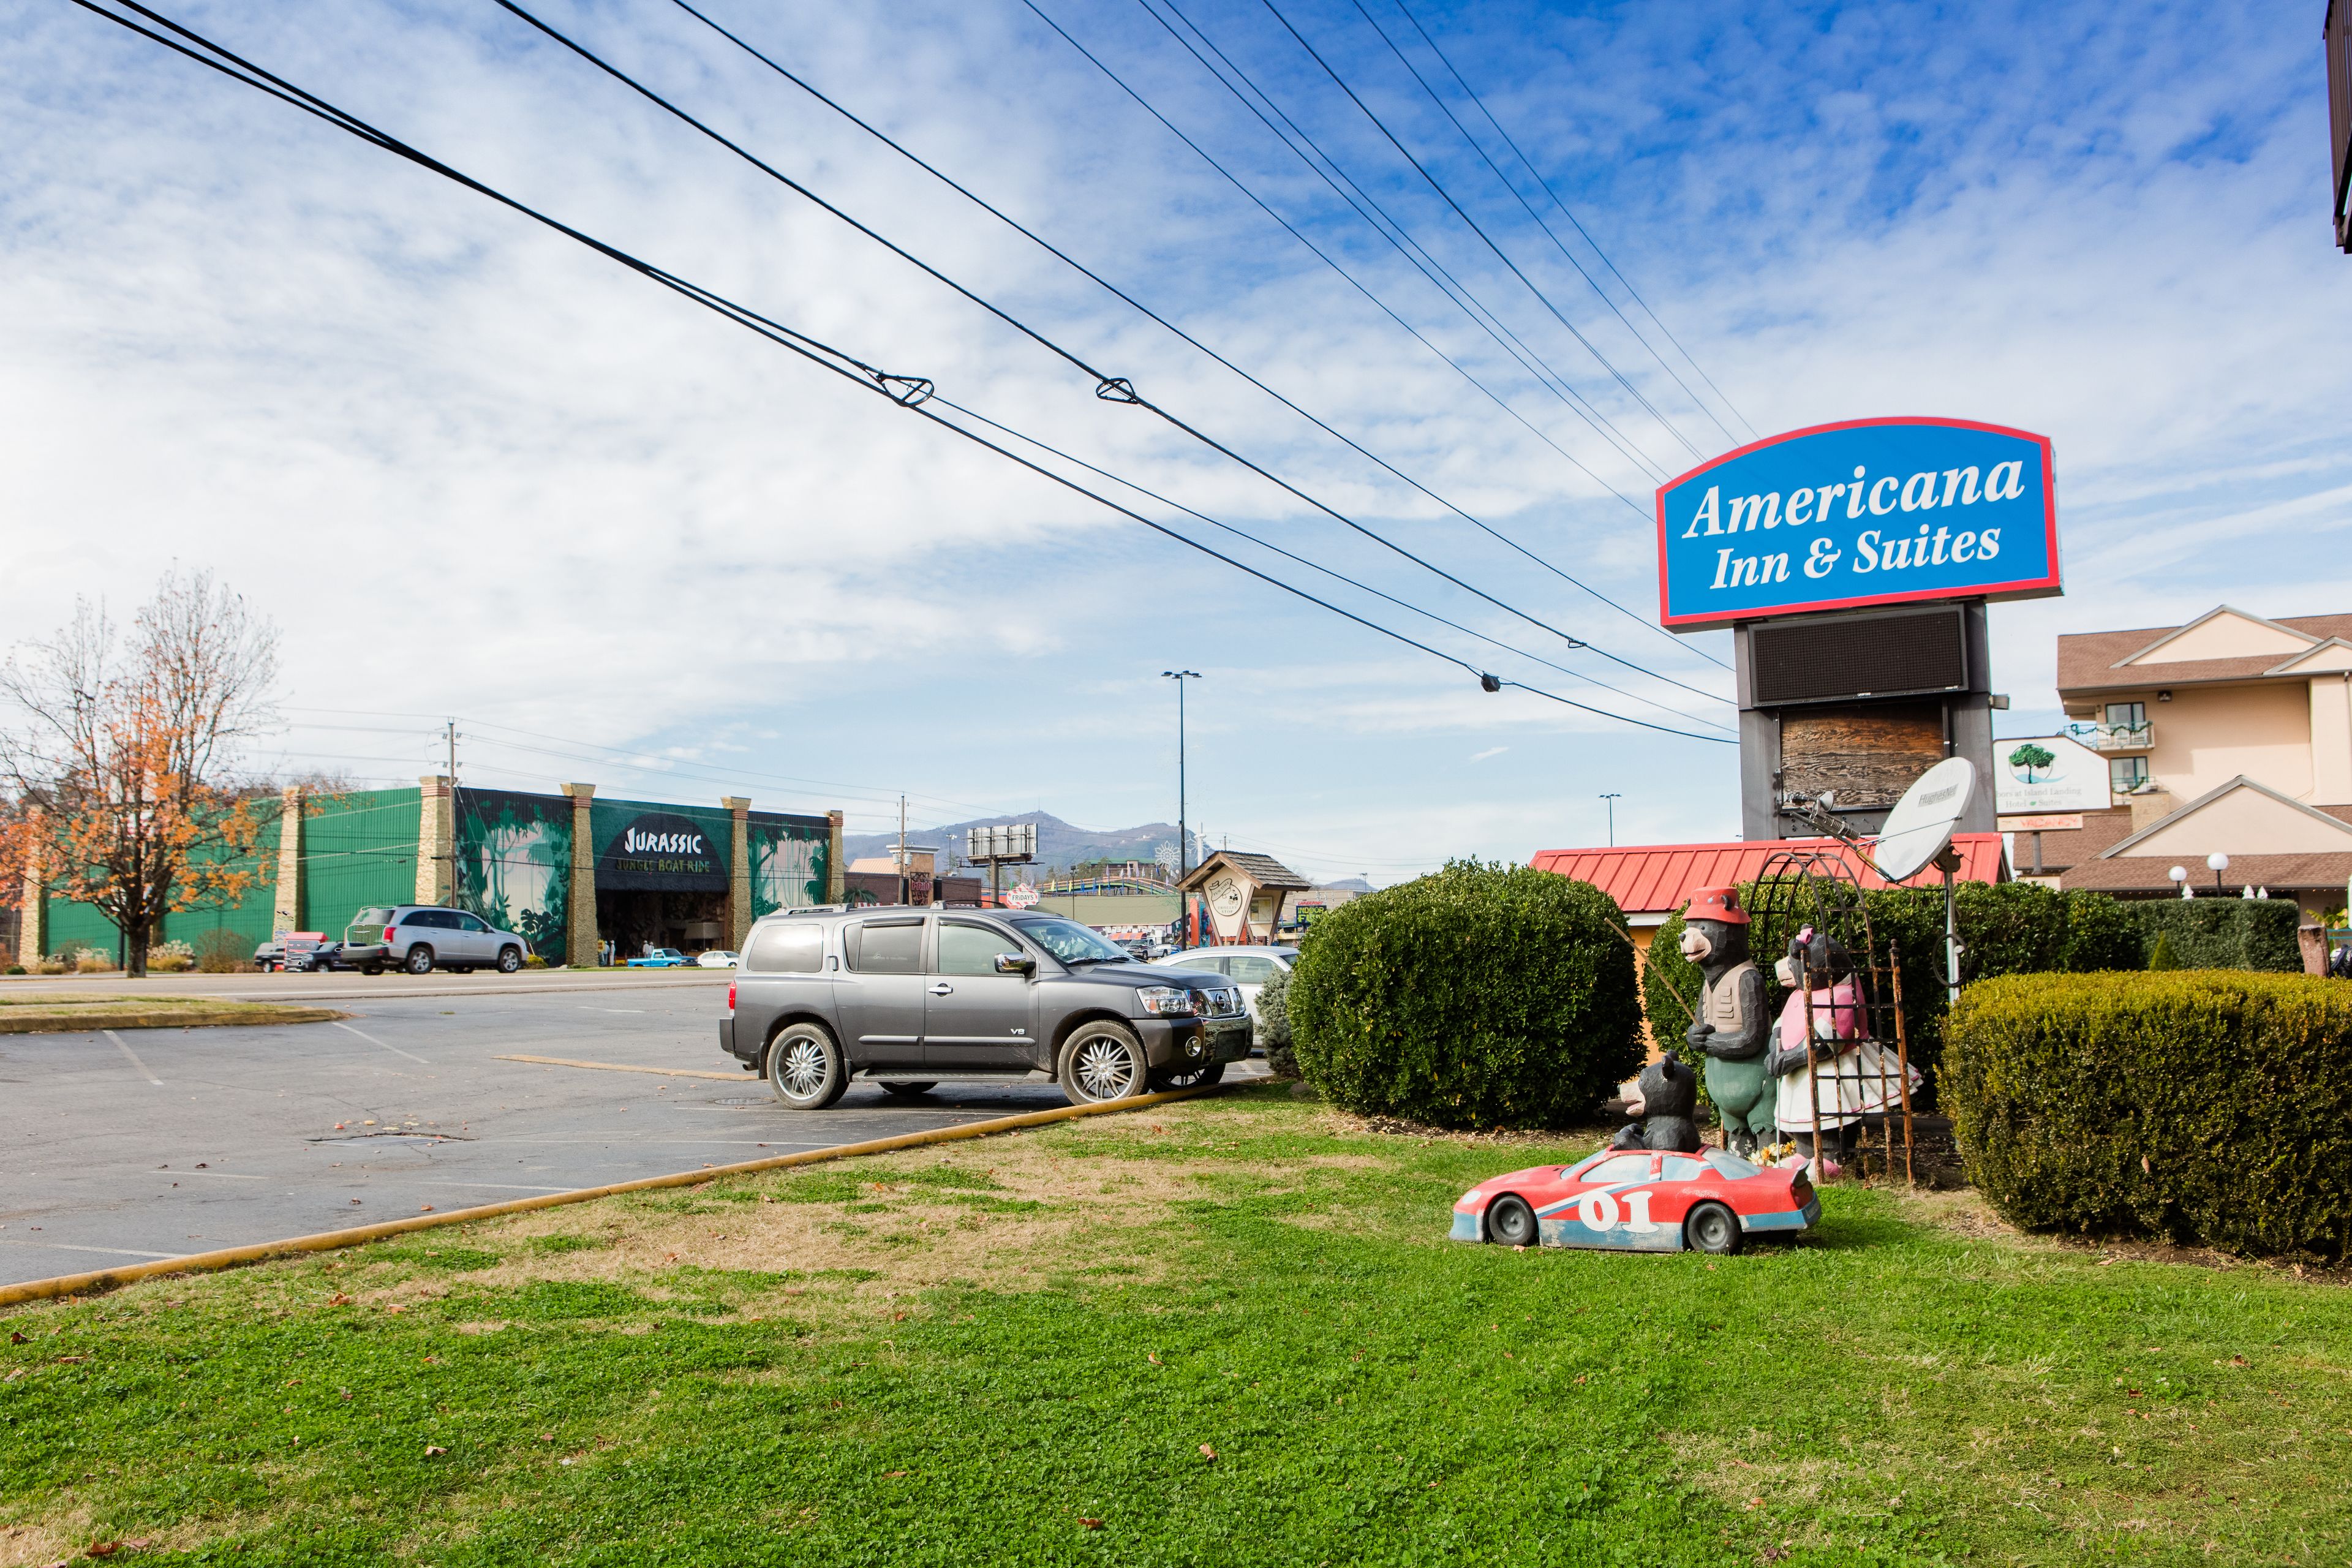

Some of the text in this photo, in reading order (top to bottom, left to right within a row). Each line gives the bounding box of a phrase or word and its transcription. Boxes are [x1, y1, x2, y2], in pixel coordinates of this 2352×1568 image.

[1682, 461, 2025, 539] Americana
[1709, 524, 2001, 589] Inn & Suites
[1918, 785, 1958, 805] HughesNet
[2024, 788, 2048, 796] Island
[2050, 786, 2081, 796] Landing
[625, 827, 701, 854] JURASSIC
[616, 858, 710, 873] JUNGLE BOAT RIDE
[1578, 1189, 1660, 1234] 01
